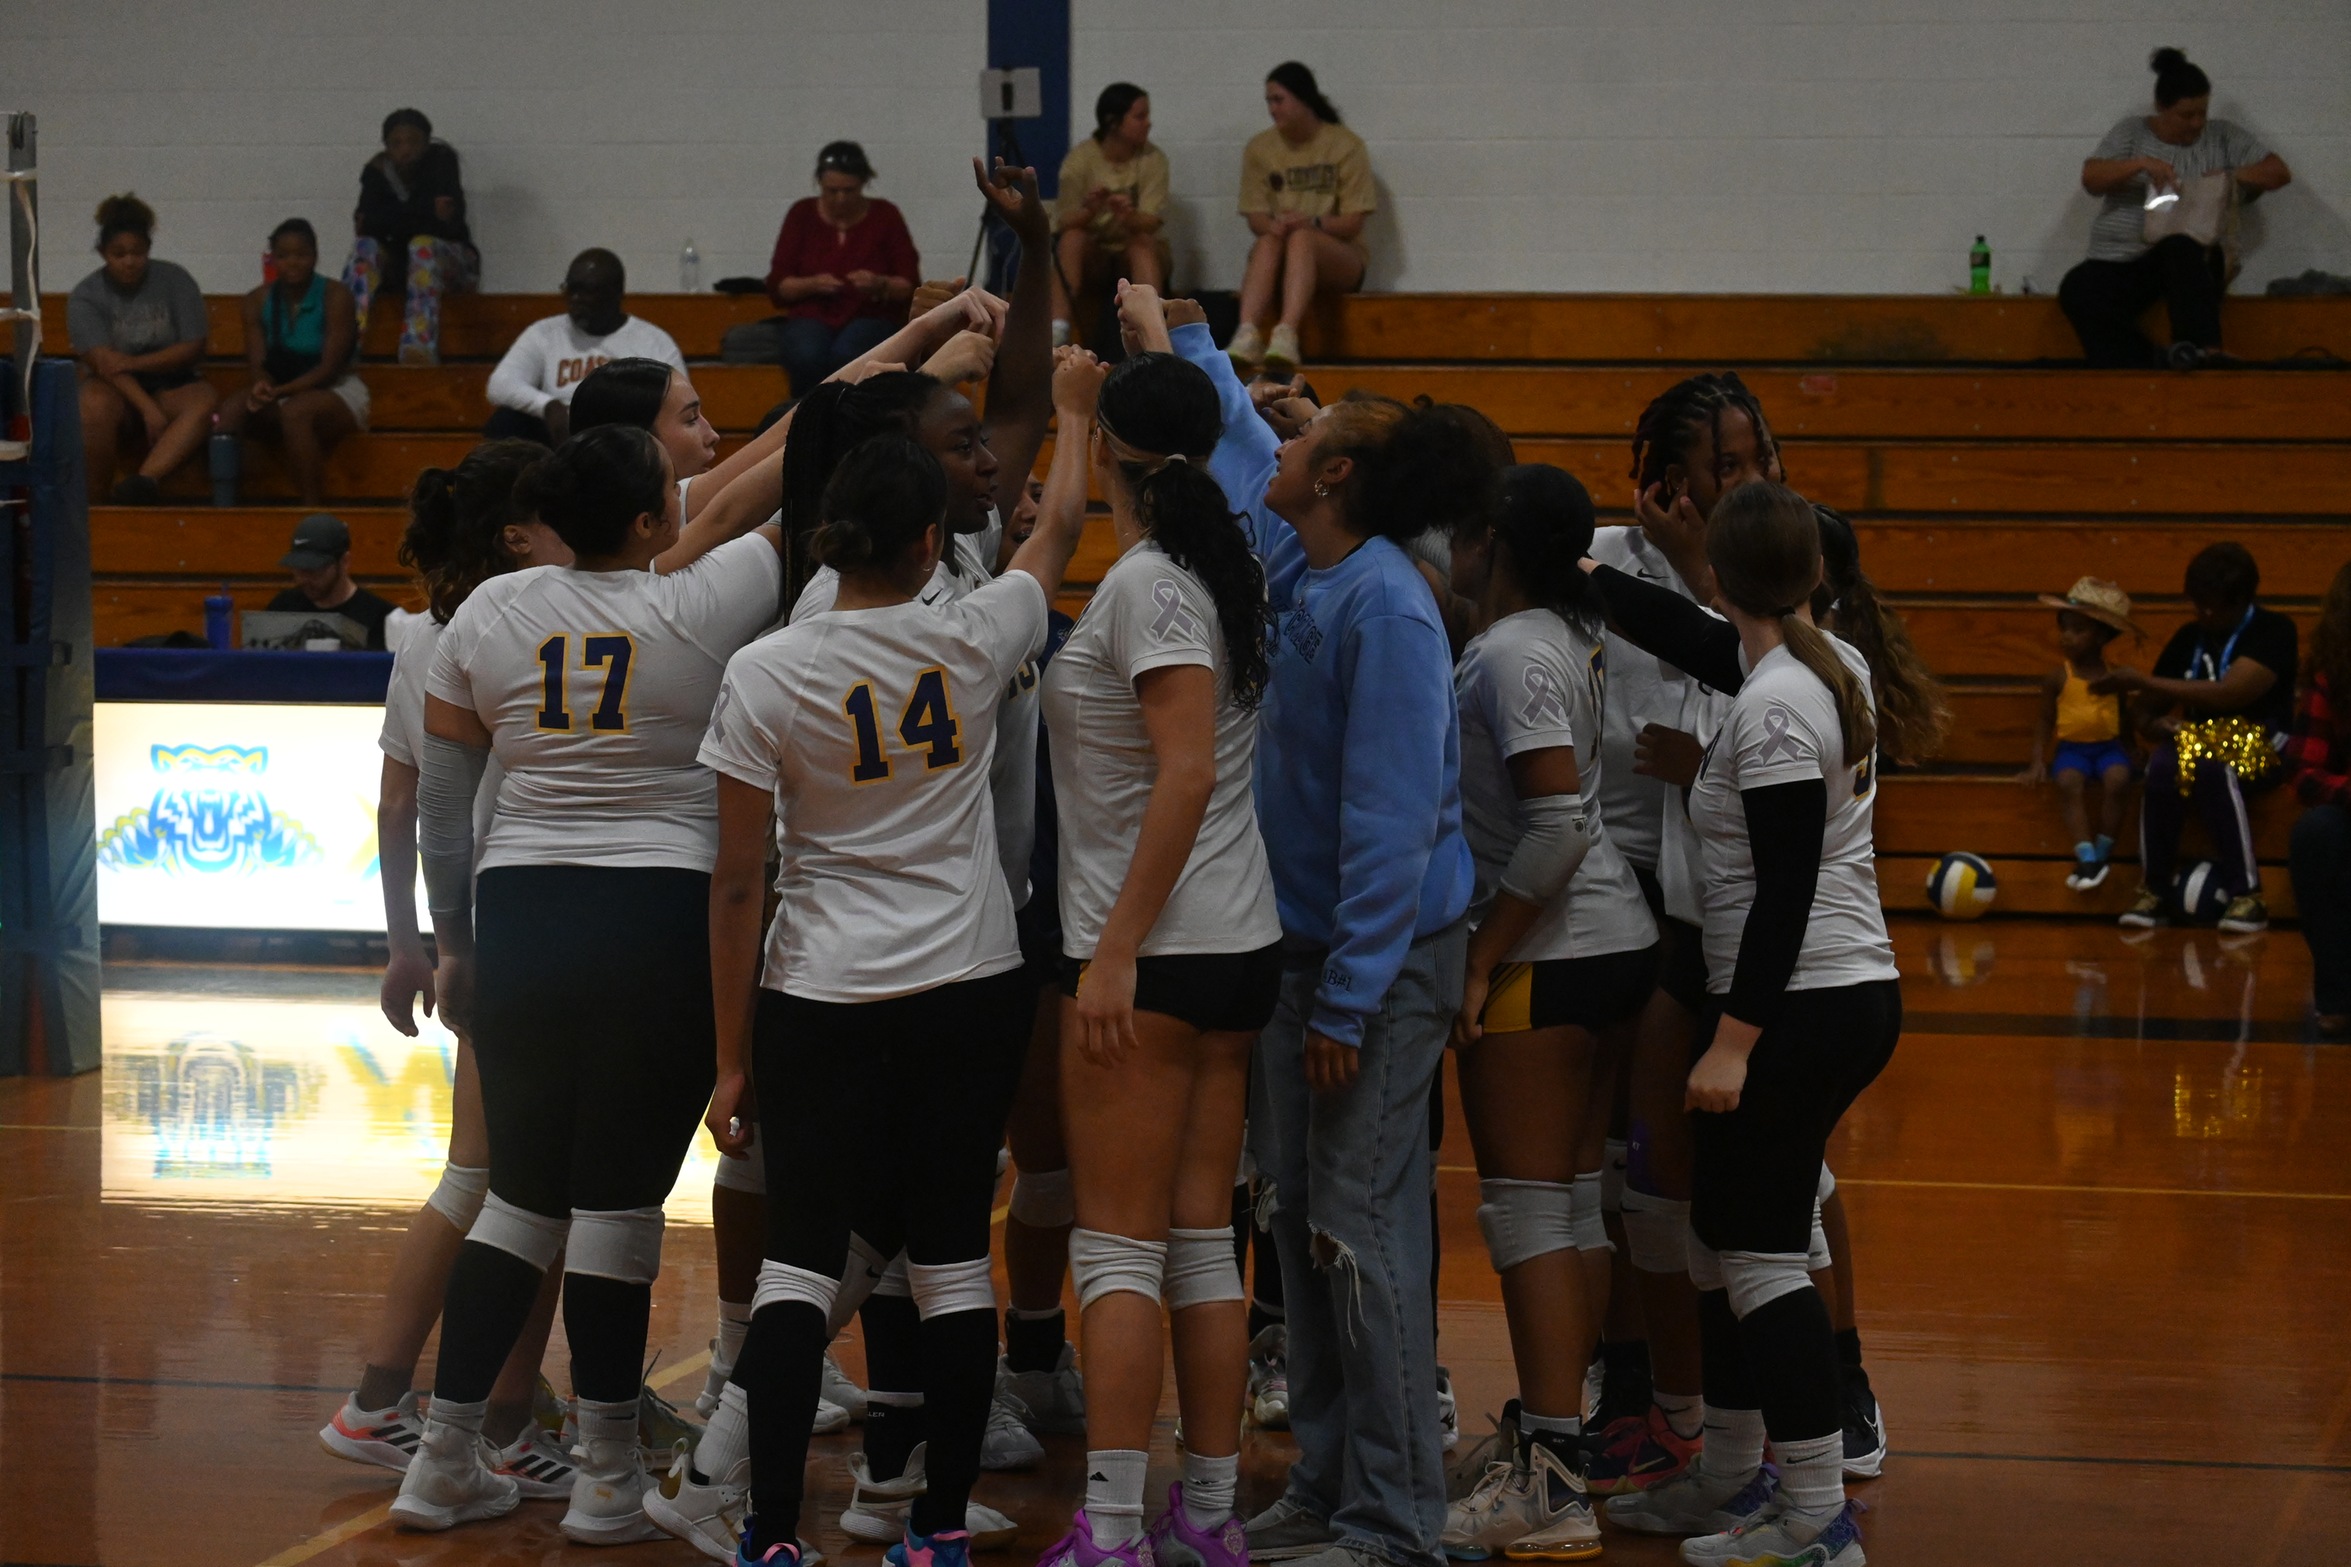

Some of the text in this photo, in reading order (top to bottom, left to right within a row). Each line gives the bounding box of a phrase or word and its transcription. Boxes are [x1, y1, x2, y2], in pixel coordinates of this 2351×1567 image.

[537, 631, 636, 734] 17
[842, 665, 965, 784] 14
[1323, 969, 1351, 991] B#1
